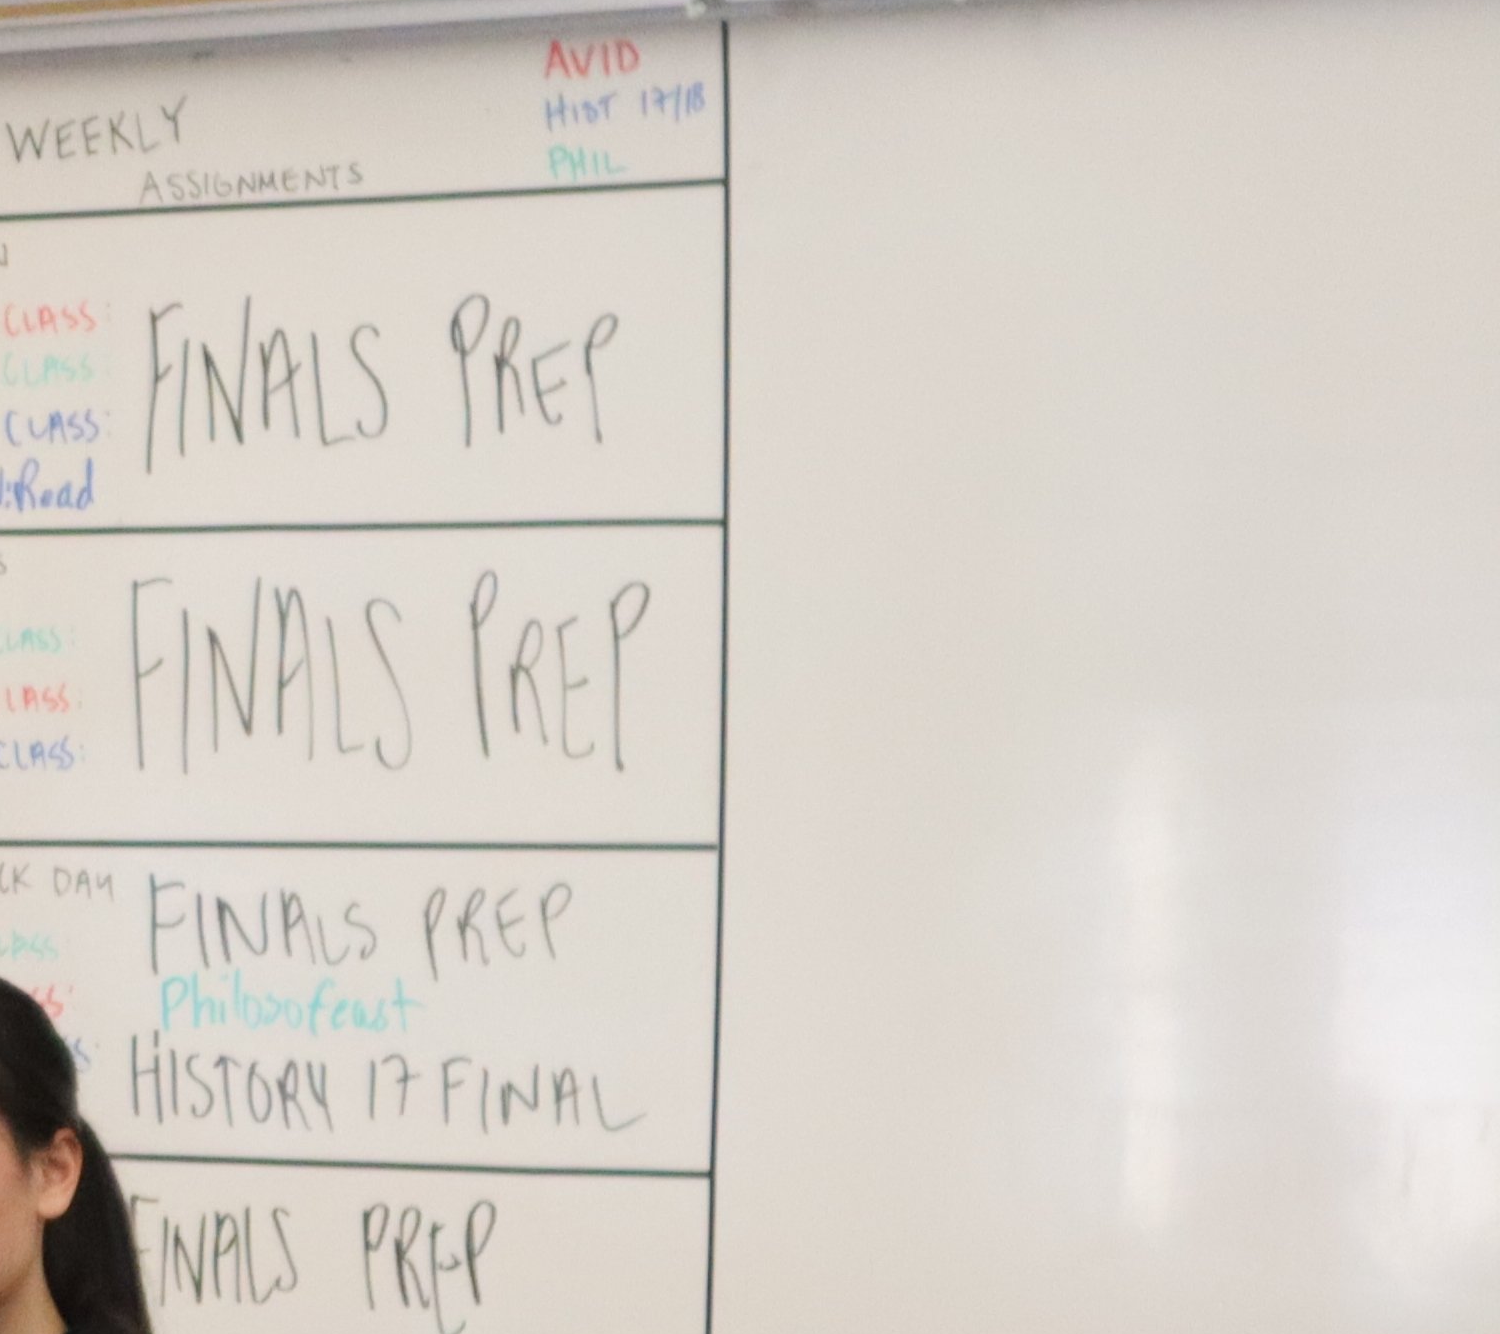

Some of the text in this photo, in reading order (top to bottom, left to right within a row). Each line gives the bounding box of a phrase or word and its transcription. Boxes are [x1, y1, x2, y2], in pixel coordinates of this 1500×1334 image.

[544, 38, 640, 79] AVID
[5, 95, 188, 164] WEEKLY
[548, 144, 627, 183] PHIL
[139, 162, 364, 204] ASSIGNMENTS
[145, 293, 619, 474] FINALS PREP
[131, 569, 650, 774] FINALS PREP
[149, 873, 573, 982] FINALS PREP
[130, 1030, 334, 1133] HISTORY
[369, 1053, 420, 1120] 17
[440, 1057, 648, 1133] FINAL
